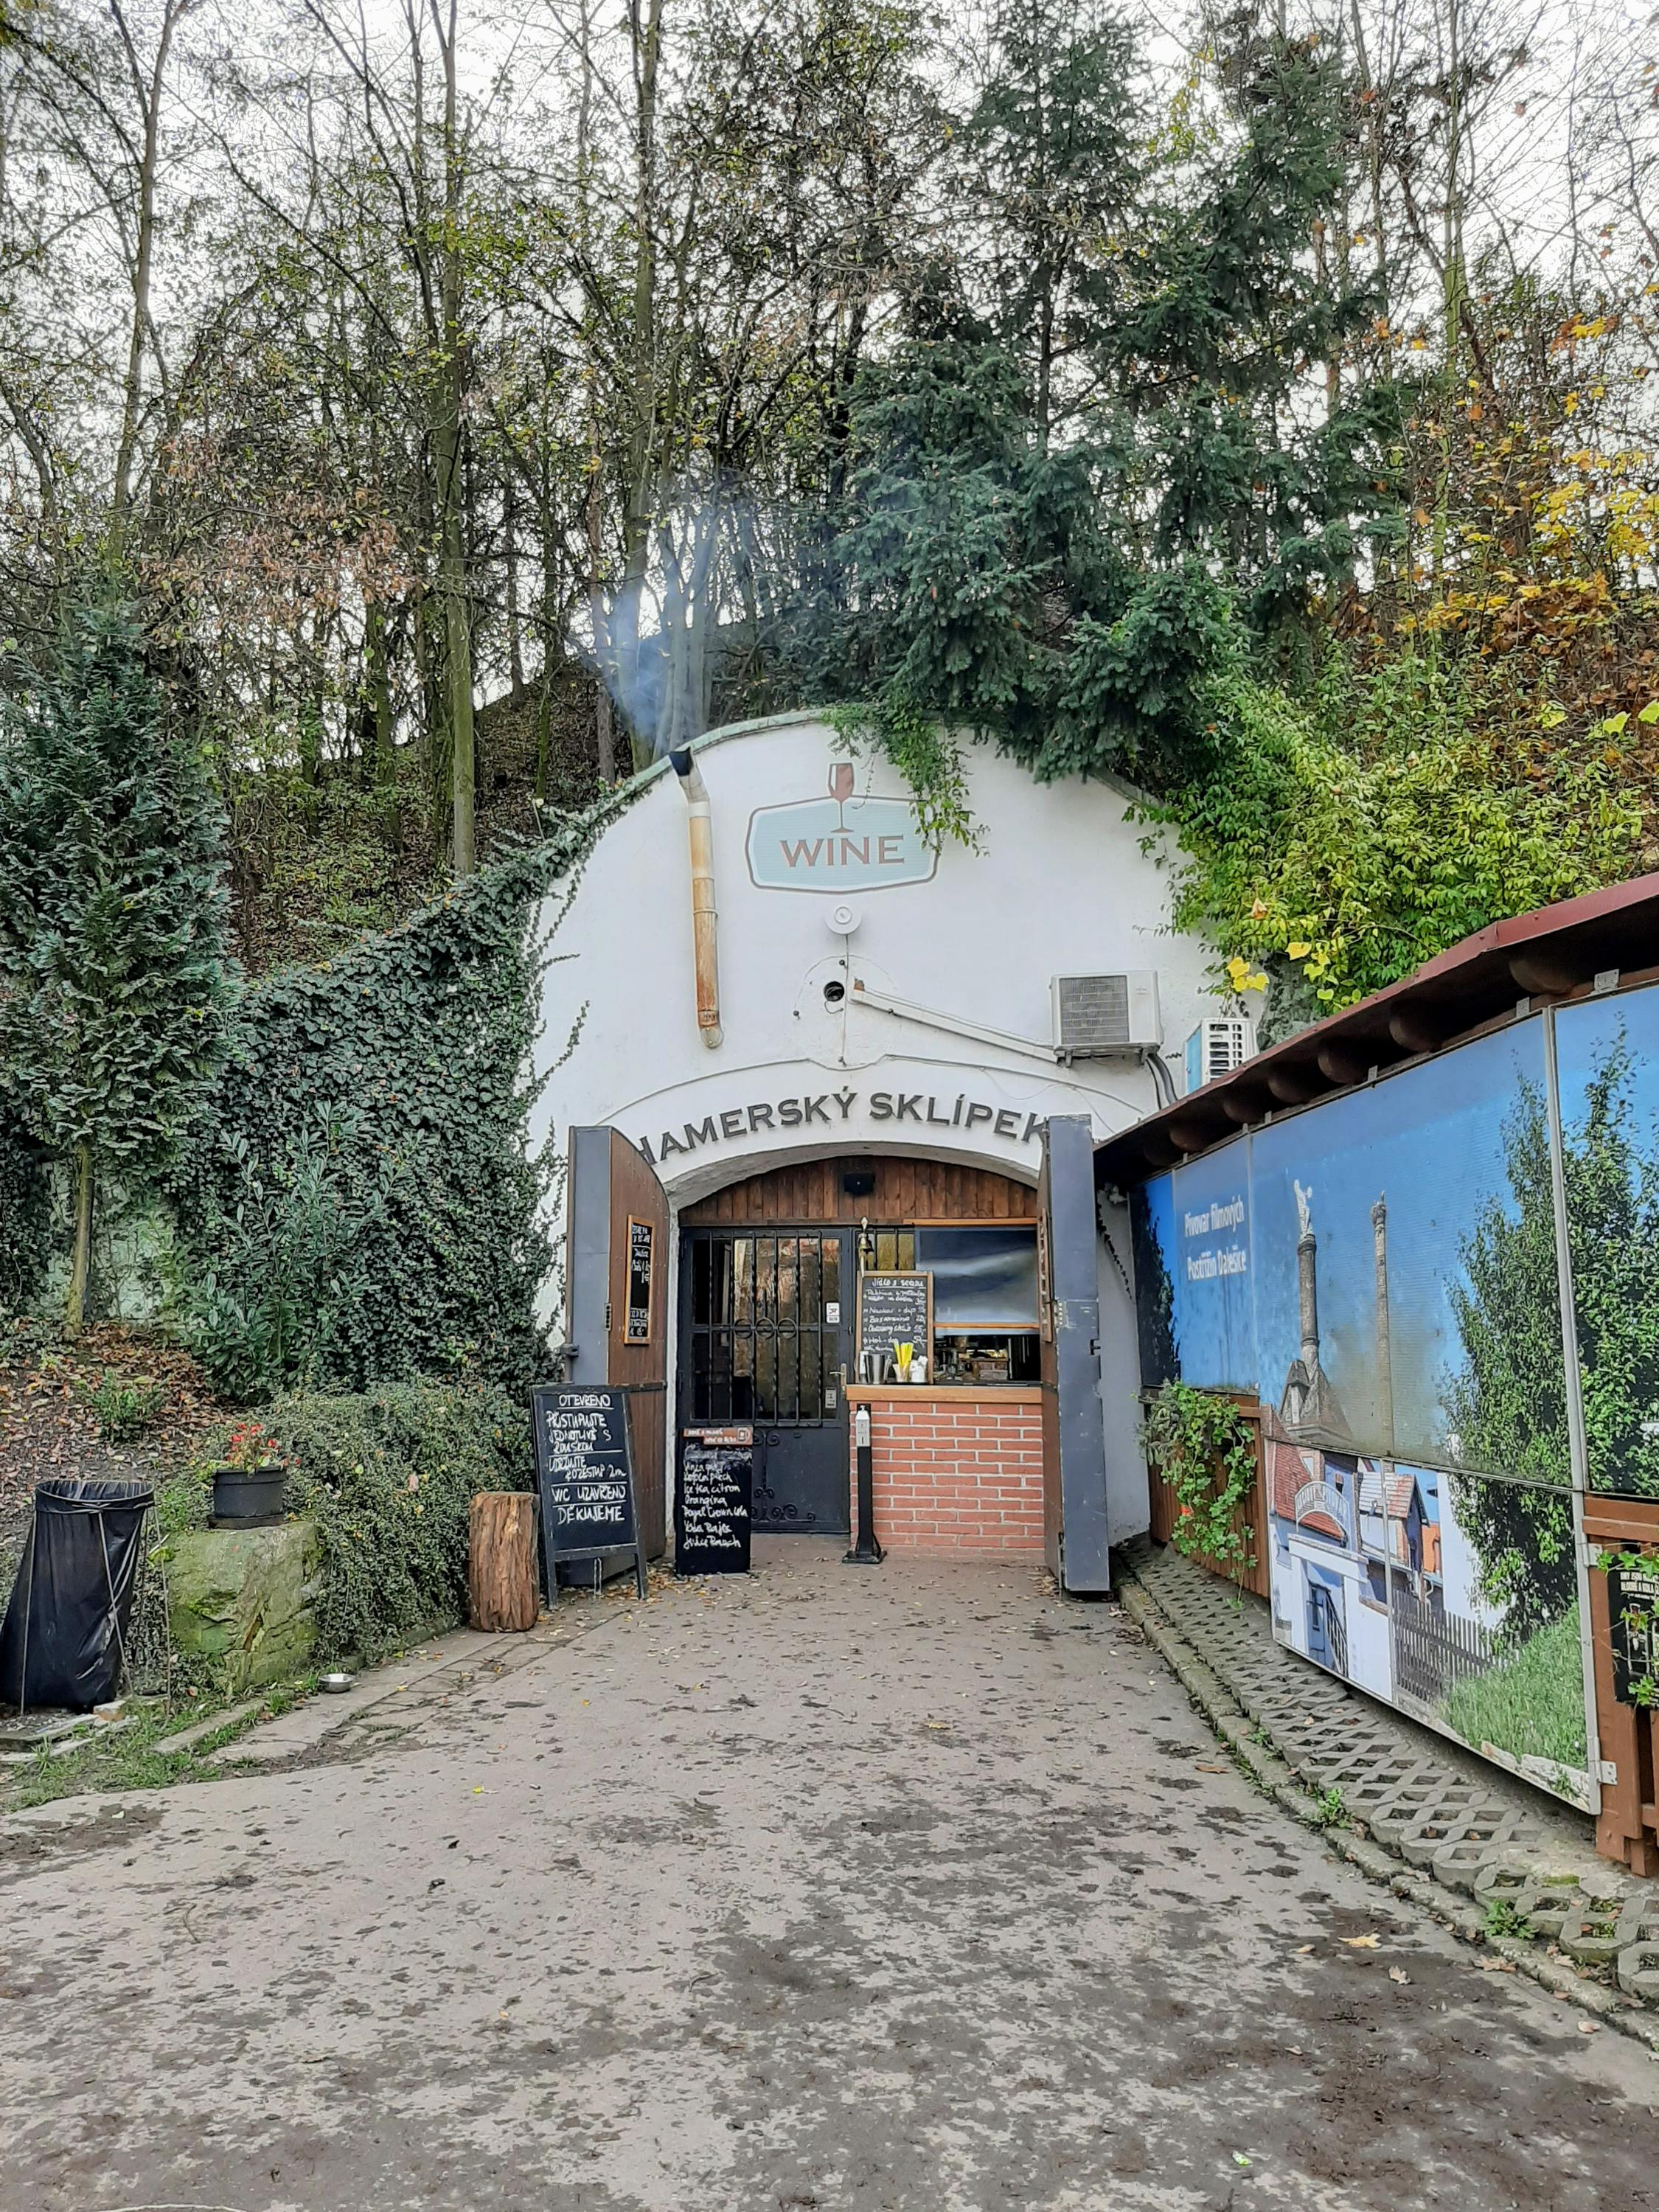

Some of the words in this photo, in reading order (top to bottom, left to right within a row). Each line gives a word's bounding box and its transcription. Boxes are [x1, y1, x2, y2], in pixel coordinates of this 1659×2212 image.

[779, 834, 905, 868] WINE
[636, 1085, 858, 1166] HAMERSKÝ
[869, 1093, 1048, 1146] SKLÍPEK
[1184, 1211, 1210, 1238] Pivovar
[1210, 1194, 1245, 1234] filmových
[557, 1505, 625, 1525] DĚKUJEME
